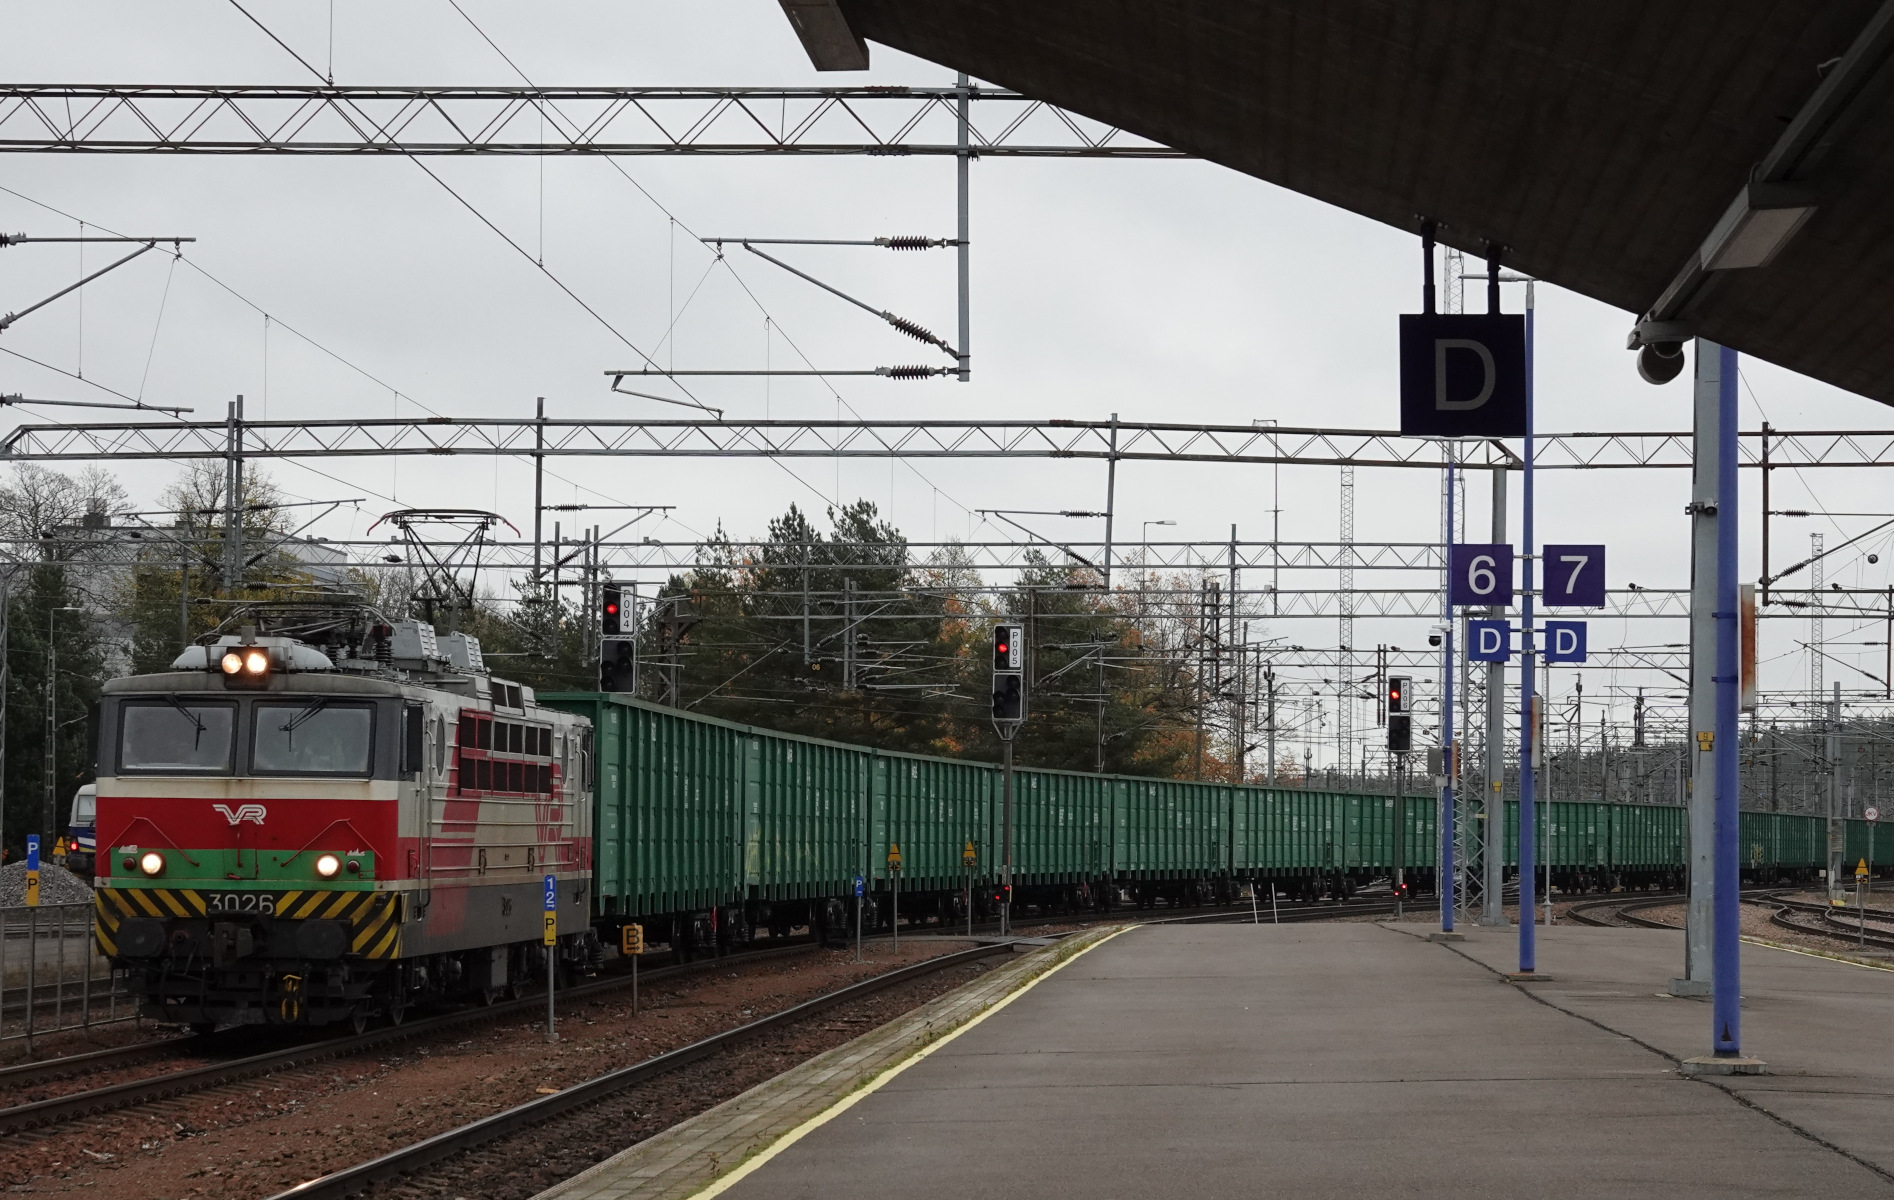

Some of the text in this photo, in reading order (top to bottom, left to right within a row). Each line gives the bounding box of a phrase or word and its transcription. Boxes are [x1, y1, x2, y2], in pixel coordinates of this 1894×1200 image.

[1435, 338, 1497, 411] D
[1468, 555, 1497, 595] 6
[1560, 555, 1589, 595] 7
[1479, 627, 1502, 654] D
[1556, 628, 1578, 655] D
[212, 804, 267, 826] VR
[28, 842, 38, 855] P
[28, 878, 38, 891] P
[856, 879, 863, 888] P
[209, 893, 274, 915] 3026
[545, 917, 555, 931] P
[626, 928, 640, 945] B
